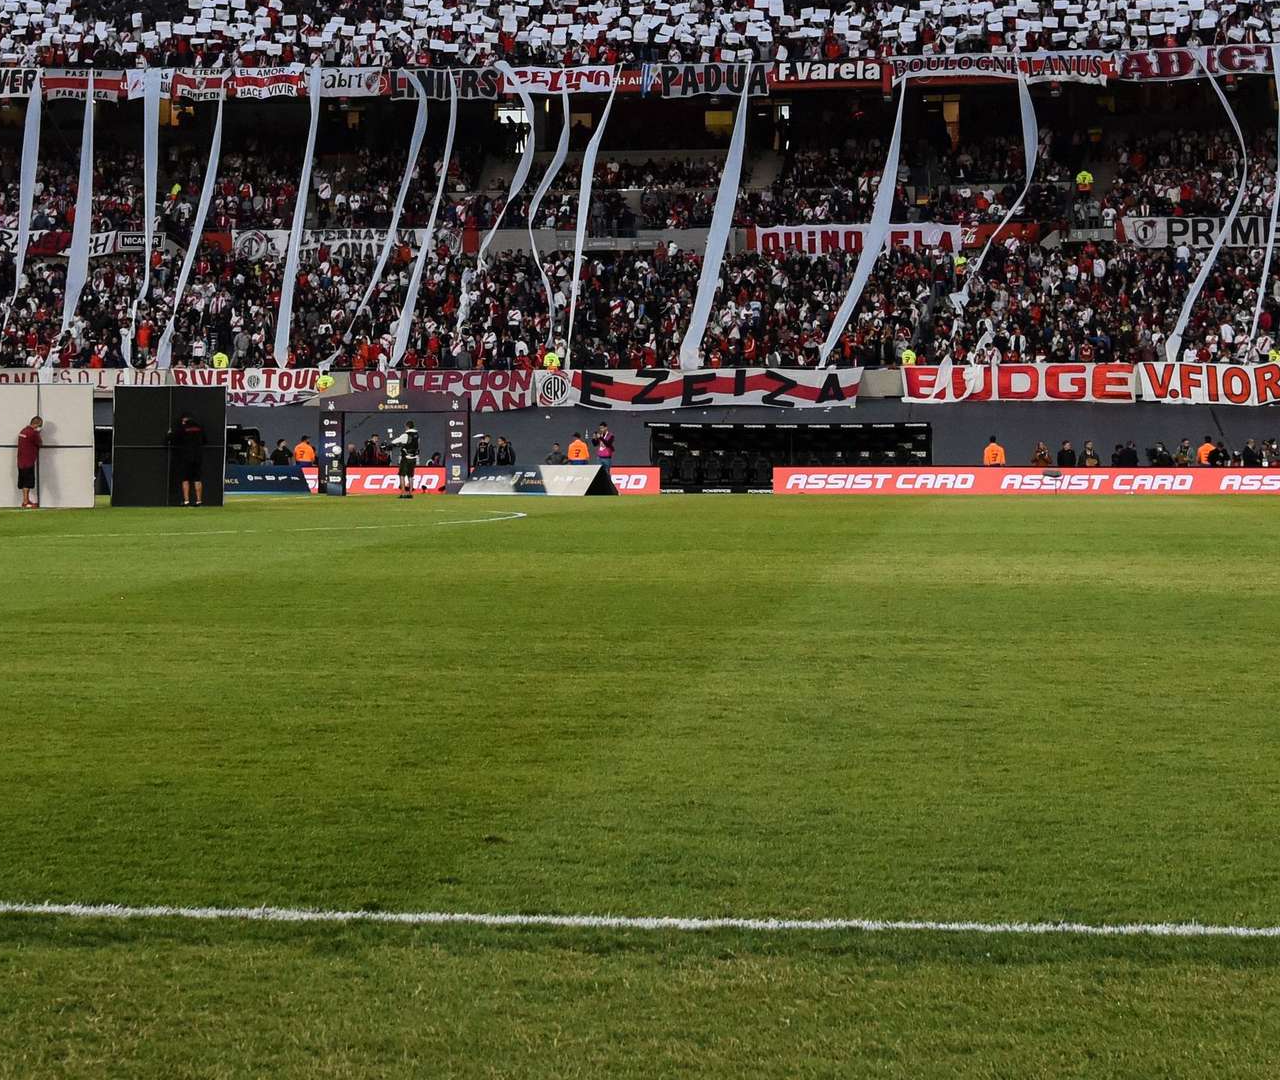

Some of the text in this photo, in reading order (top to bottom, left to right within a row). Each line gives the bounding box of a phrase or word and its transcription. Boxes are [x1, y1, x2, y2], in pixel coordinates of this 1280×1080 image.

[256, 68, 286, 77] AMOR
[777, 61, 881, 82] F.Varela
[1028, 54, 1103, 78] LANUS
[662, 62, 767, 97] PADUA
[240, 86, 294, 98] HACE VIVIR
[172, 369, 245, 391] RIVER
[579, 368, 845, 410] EZEIZA
[786, 474, 975, 488] ASSIST CARD
[1001, 474, 1194, 489] ASSIST CARD
